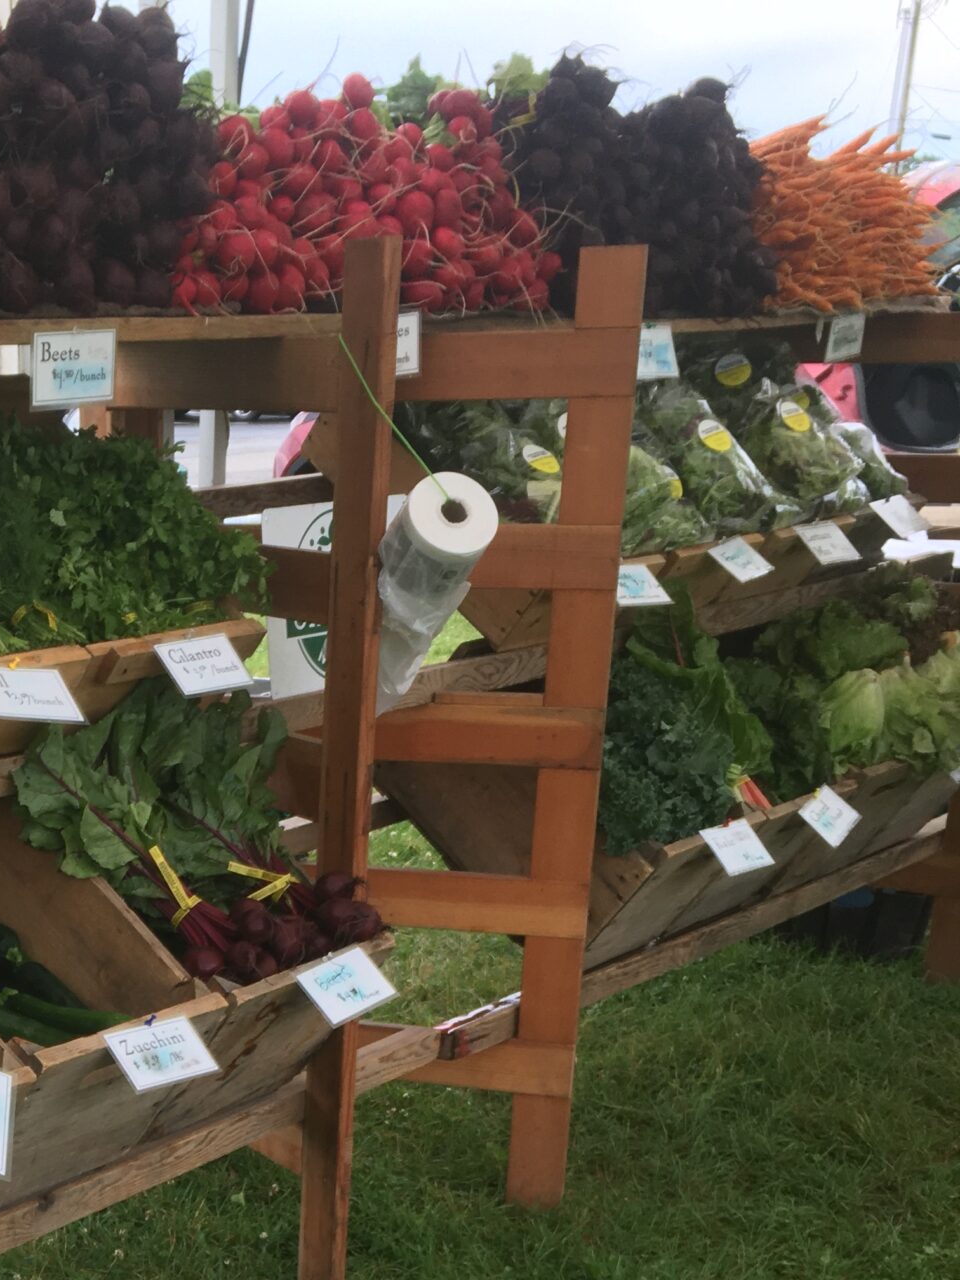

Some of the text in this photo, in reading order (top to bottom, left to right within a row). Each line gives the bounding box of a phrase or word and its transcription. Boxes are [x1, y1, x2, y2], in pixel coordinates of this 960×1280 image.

[41, 341, 81, 362] Beets
[168, 646, 222, 664] Cilantro
[118, 1026, 185, 1056] Zucchini
